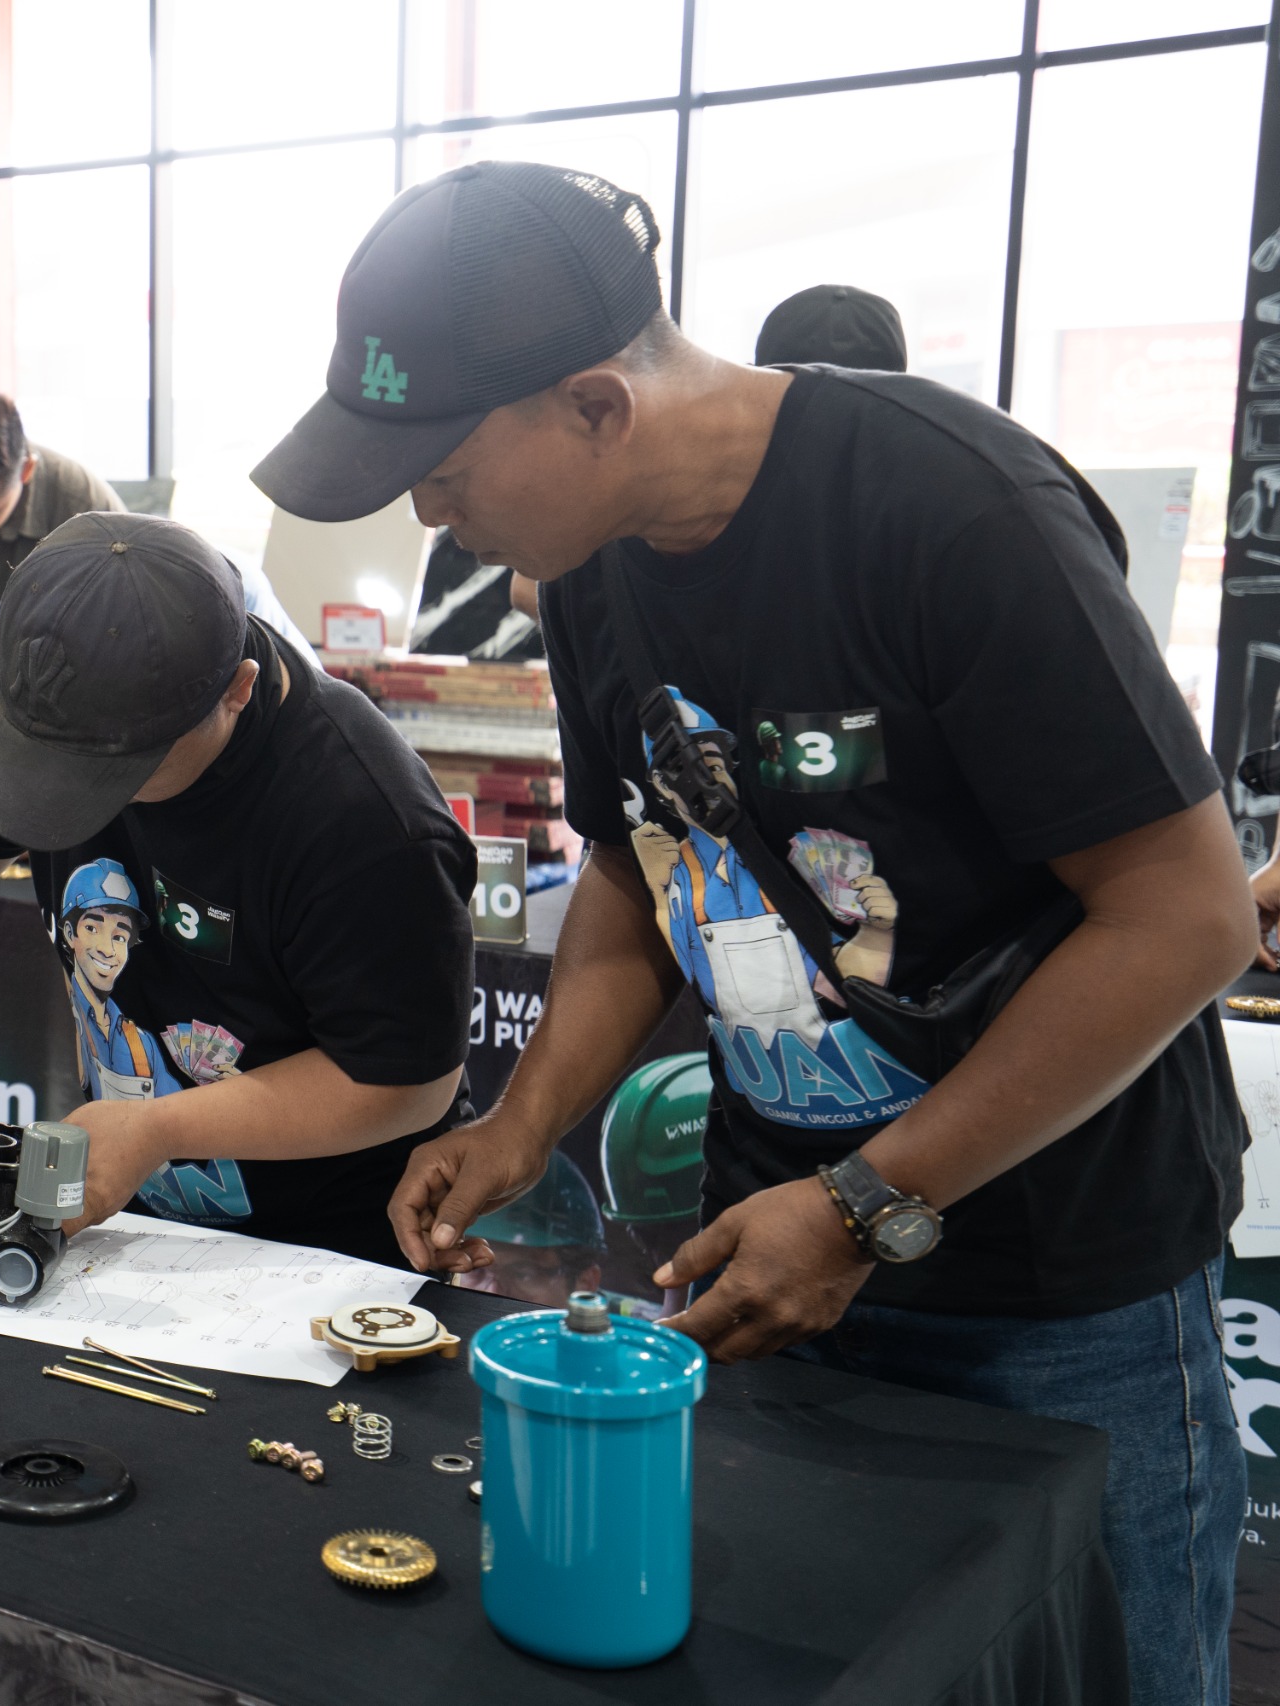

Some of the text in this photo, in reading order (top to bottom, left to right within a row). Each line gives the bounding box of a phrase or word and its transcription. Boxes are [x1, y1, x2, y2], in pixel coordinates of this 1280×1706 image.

[360, 335, 408, 404] LA
[794, 731, 837, 776] 3
[472, 882, 522, 918] 10
[175, 903, 200, 940] 3
[808, 1113, 863, 1124] UNGGUL
